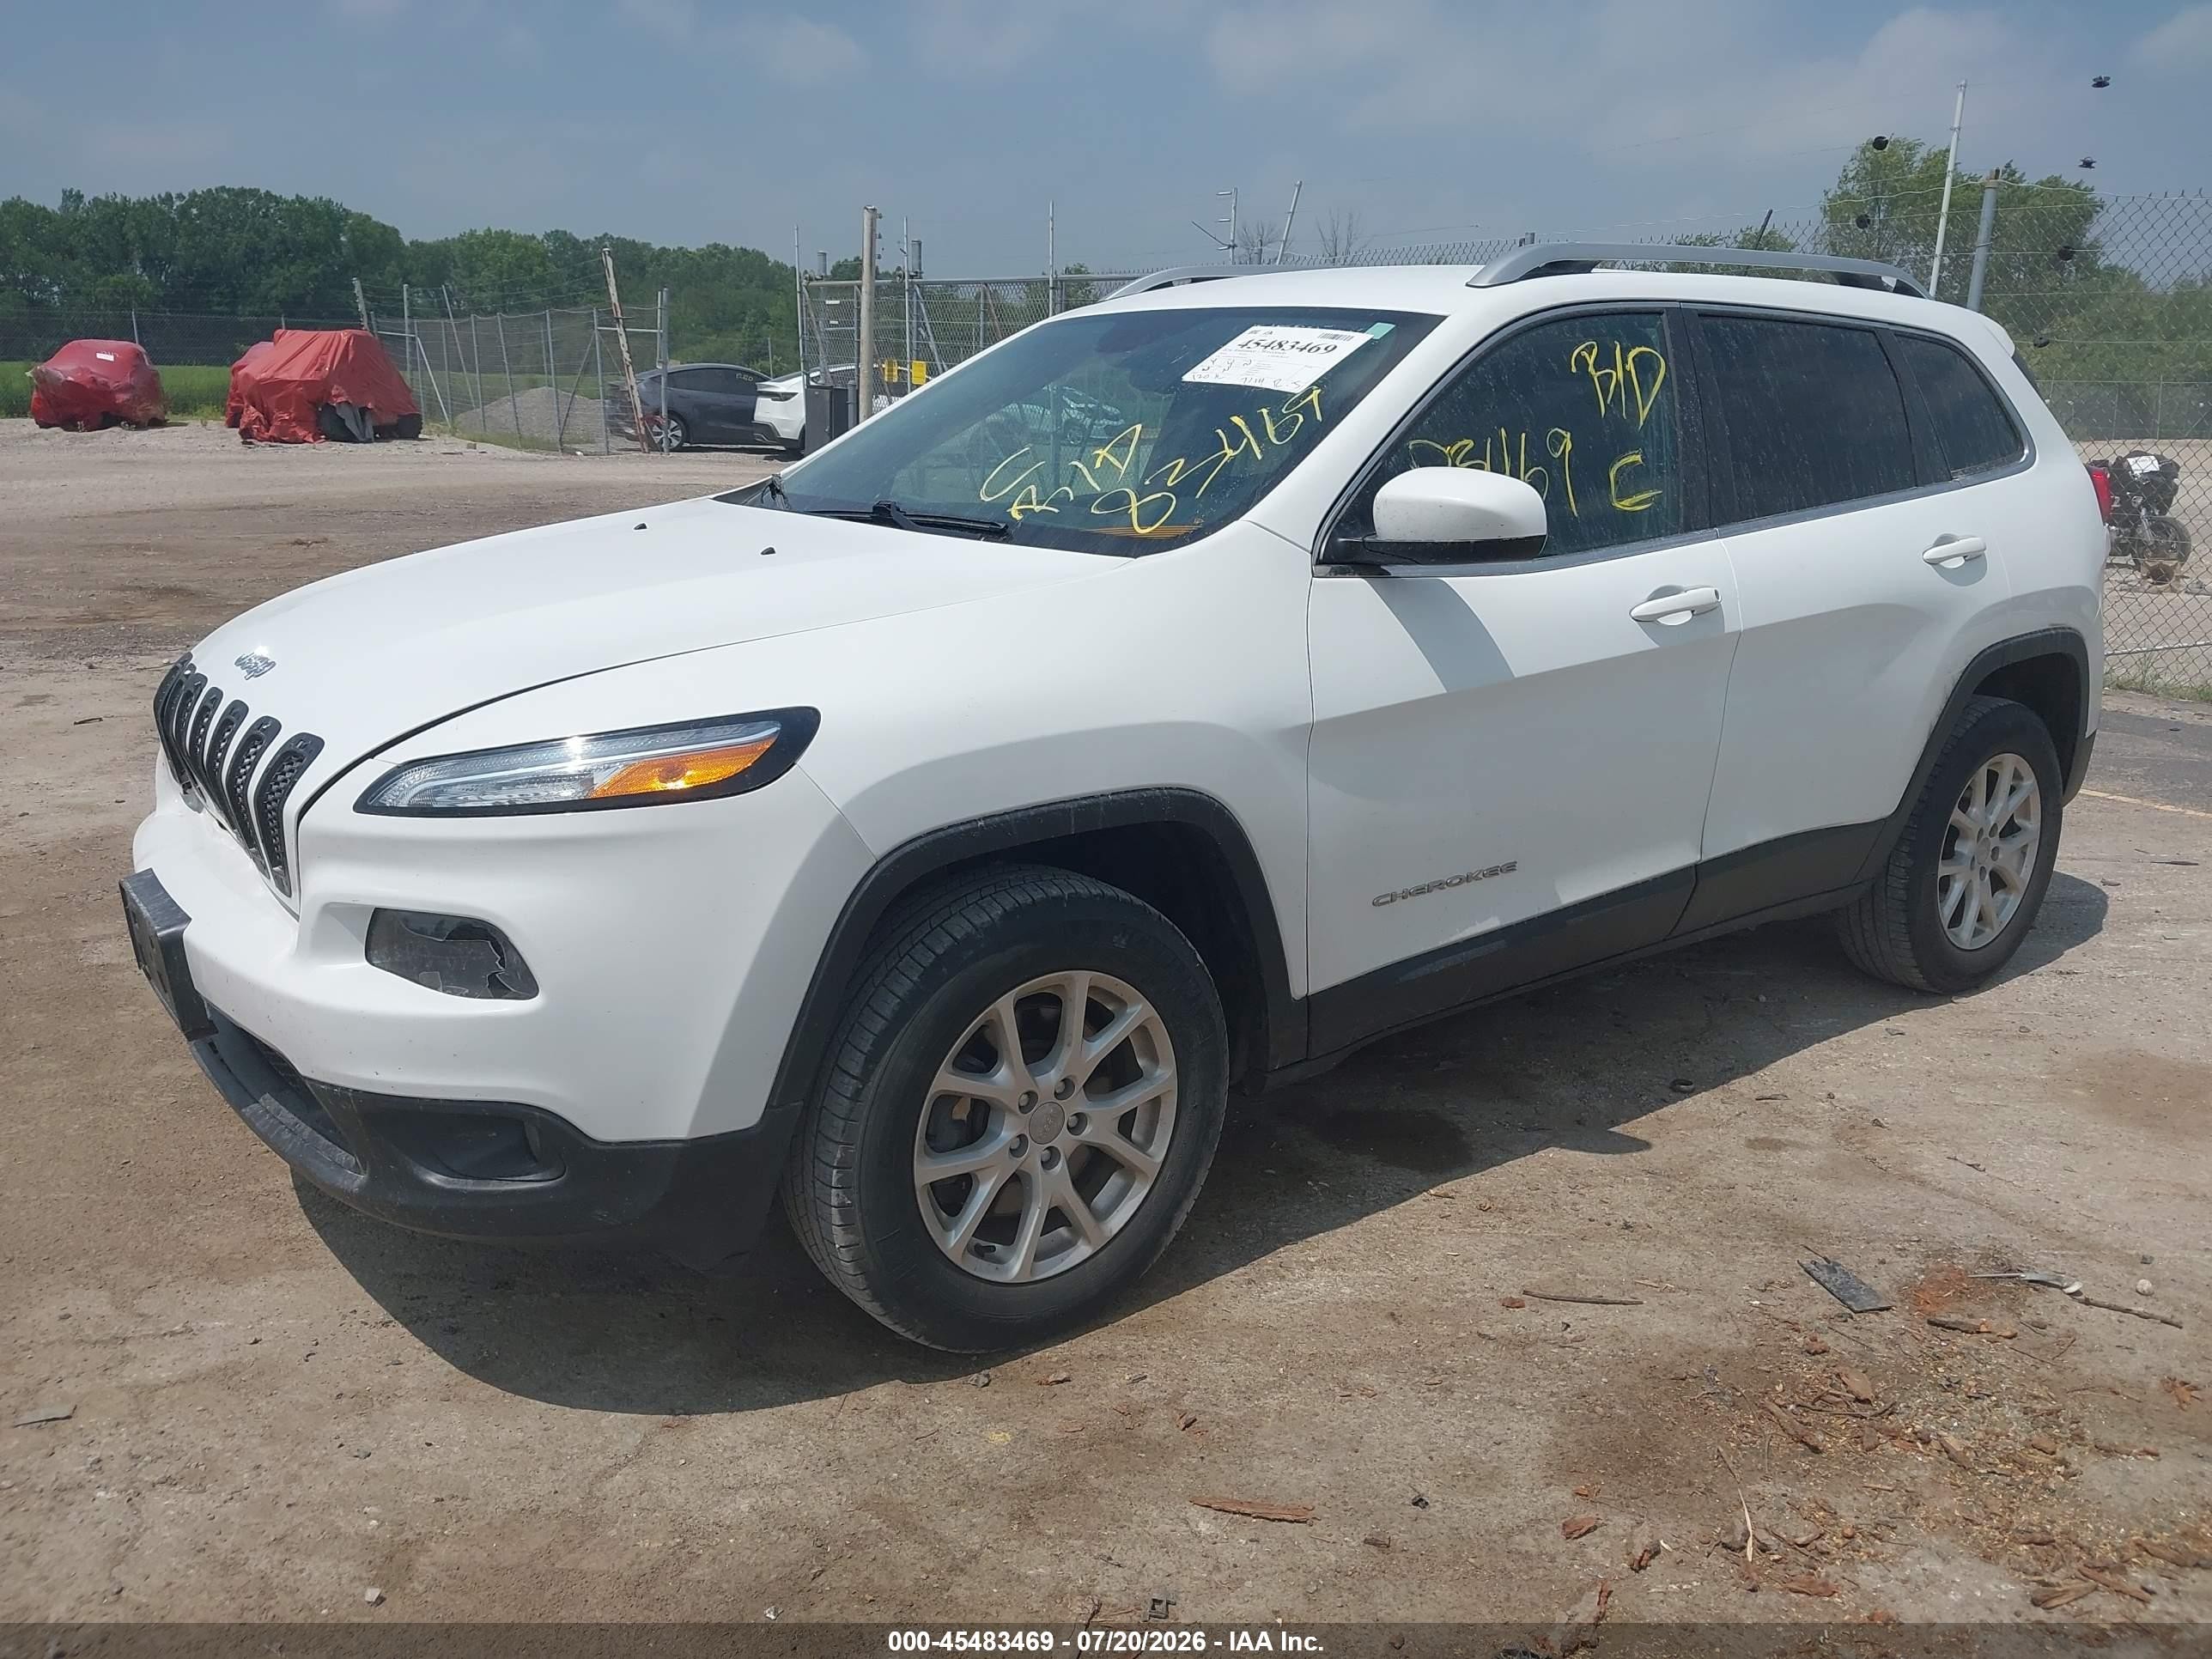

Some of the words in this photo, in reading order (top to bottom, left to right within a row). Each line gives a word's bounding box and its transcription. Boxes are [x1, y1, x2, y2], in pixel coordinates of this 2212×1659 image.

[1237, 337, 1339, 355] 45483469
[1571, 340, 1667, 430] BID
[1372, 860, 1518, 907] CHEROKEE
